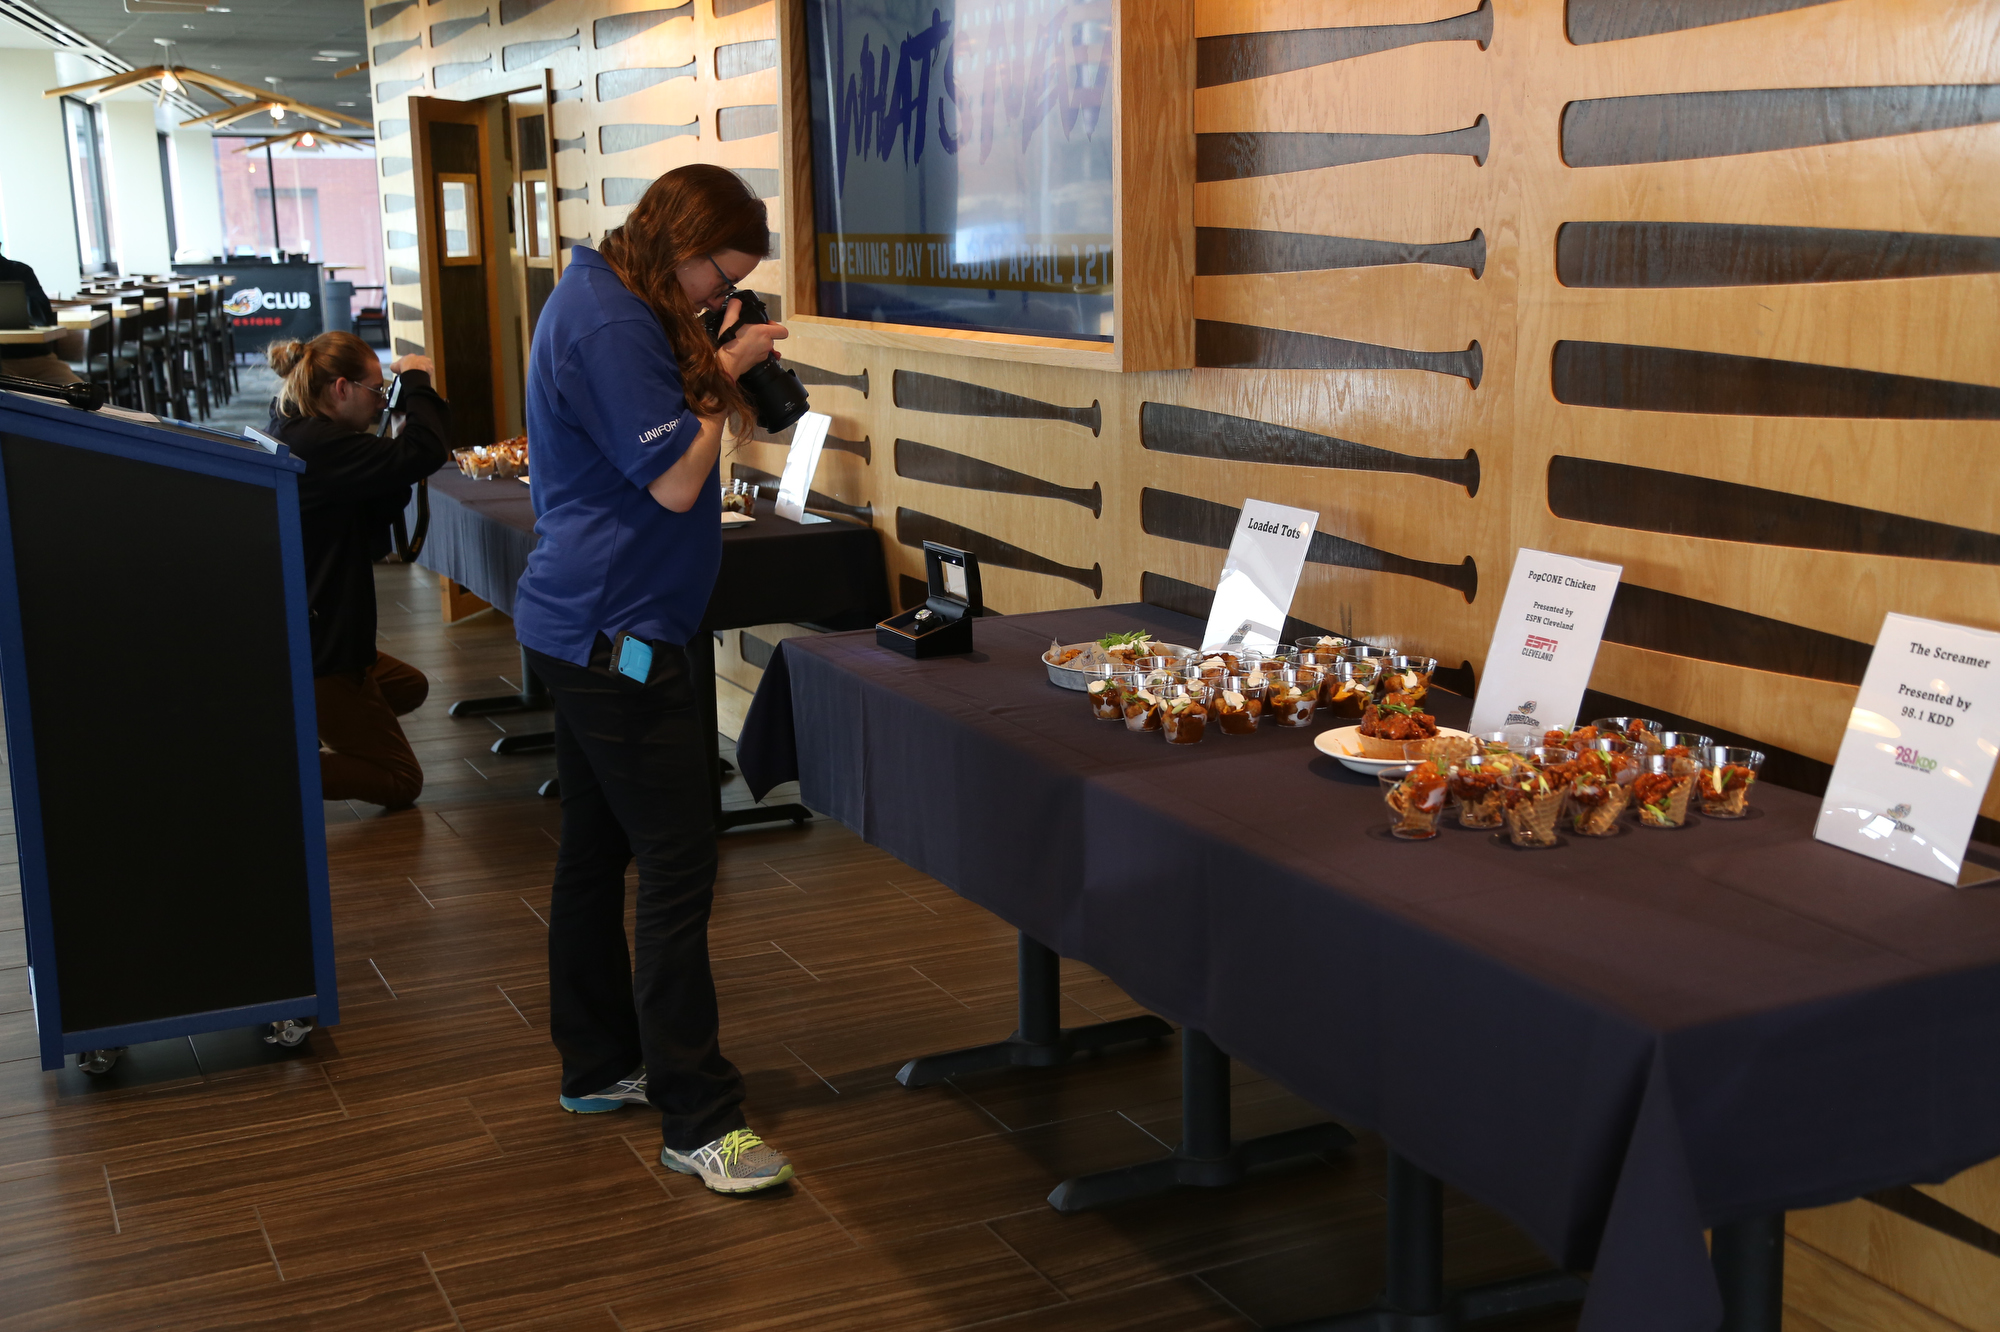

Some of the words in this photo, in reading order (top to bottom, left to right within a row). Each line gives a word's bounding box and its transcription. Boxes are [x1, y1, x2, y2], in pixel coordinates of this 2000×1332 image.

[836, 0, 973, 200] WHAT'S
[829, 241, 889, 276] OPENING
[895, 242, 922, 278] DAY
[927, 243, 1001, 281] TUESDAY
[1007, 243, 1063, 284] APRIL
[1071, 243, 1112, 285] 12T
[262, 291, 311, 309] CLUB
[233, 316, 282, 327] estone
[639, 418, 681, 443] UNIFOR
[1248, 518, 1280, 534] Loaded
[1281, 524, 1301, 539] Tots
[1528, 570, 1563, 585] PopCONE
[1564, 577, 1596, 591] Chicken
[1533, 601, 1565, 614] Presented
[1565, 608, 1574, 618] by
[1525, 613, 1542, 624] ESPN
[1542, 617, 1574, 631] Cleveland
[1525, 634, 1559, 653] ESPN
[1521, 647, 1554, 662] CLEVELAND
[1910, 642, 1931, 657] The
[1933, 647, 1991, 669] Screamer
[1898, 683, 1954, 706] Presented
[1956, 696, 1972, 712] by
[1901, 706, 1925, 721] 98.1
[1927, 712, 1955, 728] KDD
